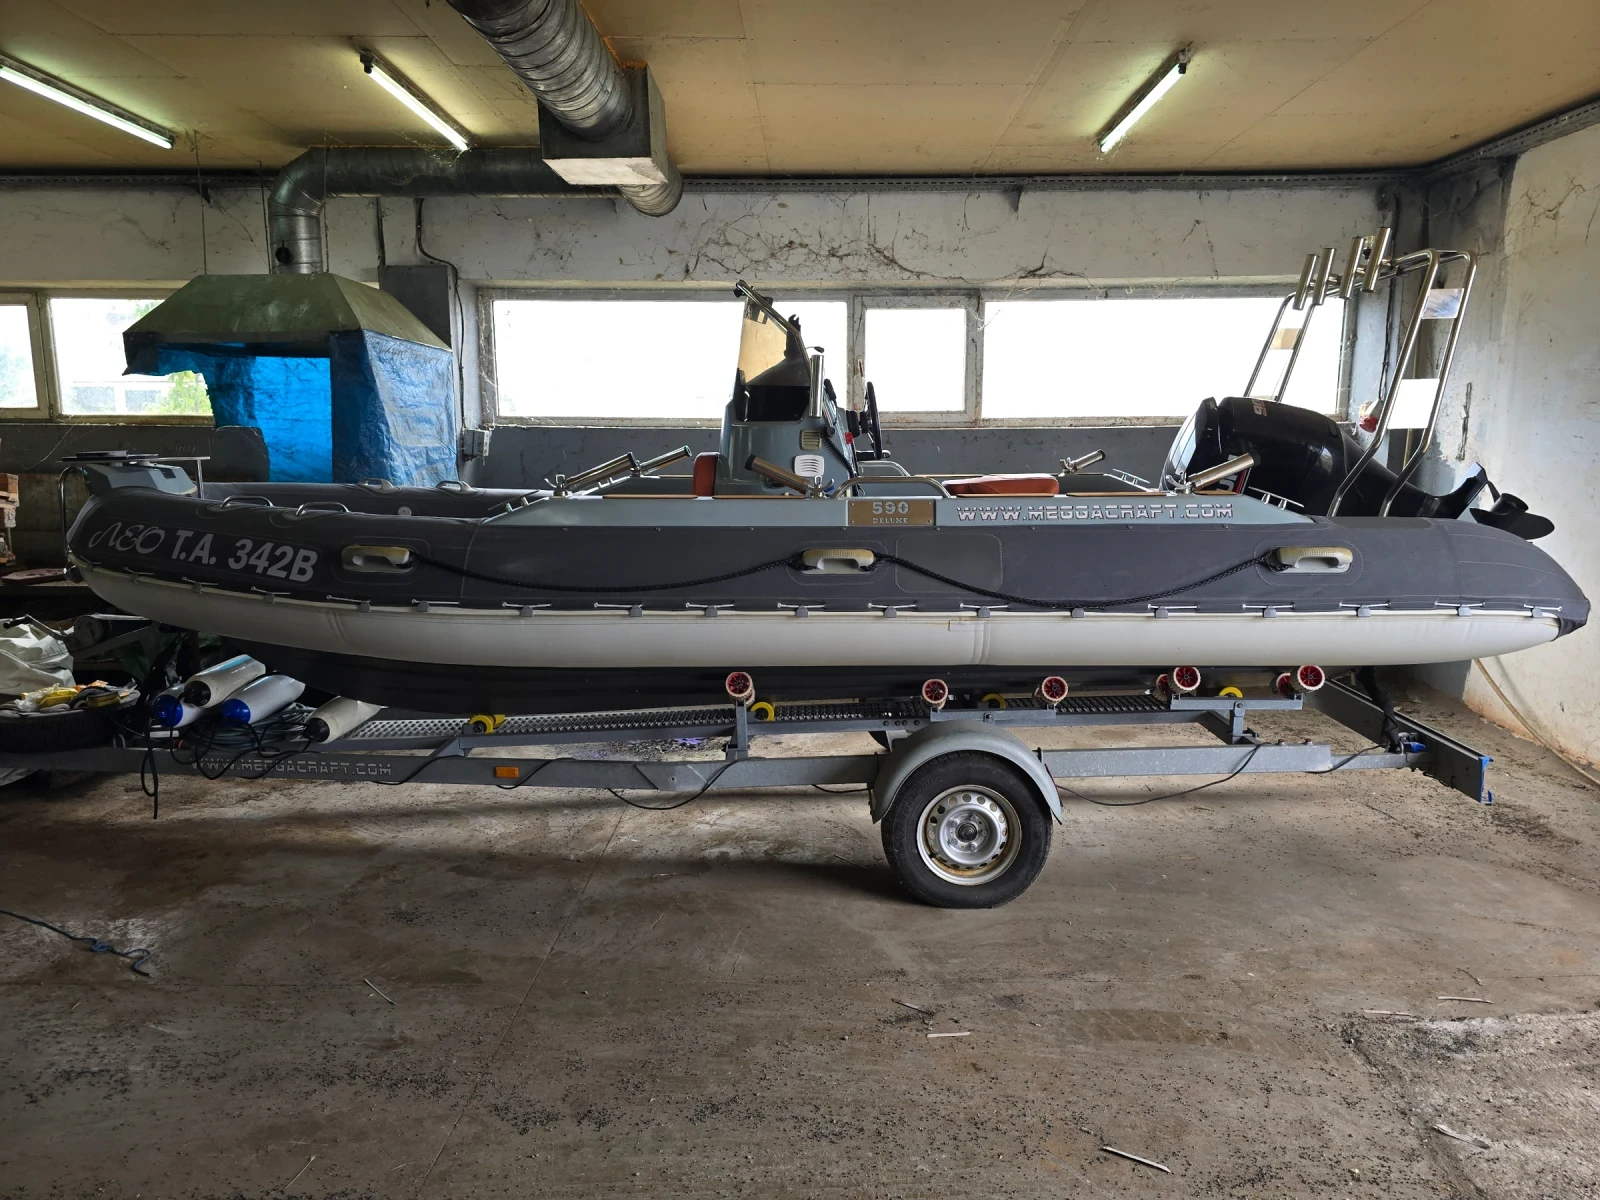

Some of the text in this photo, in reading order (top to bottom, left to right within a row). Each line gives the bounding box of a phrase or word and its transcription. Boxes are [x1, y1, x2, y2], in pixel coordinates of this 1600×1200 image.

[872, 501, 909, 515] 590
[956, 503, 1234, 521] WWW.MEGGACRAFT.COM
[228, 538, 318, 583] 342B
